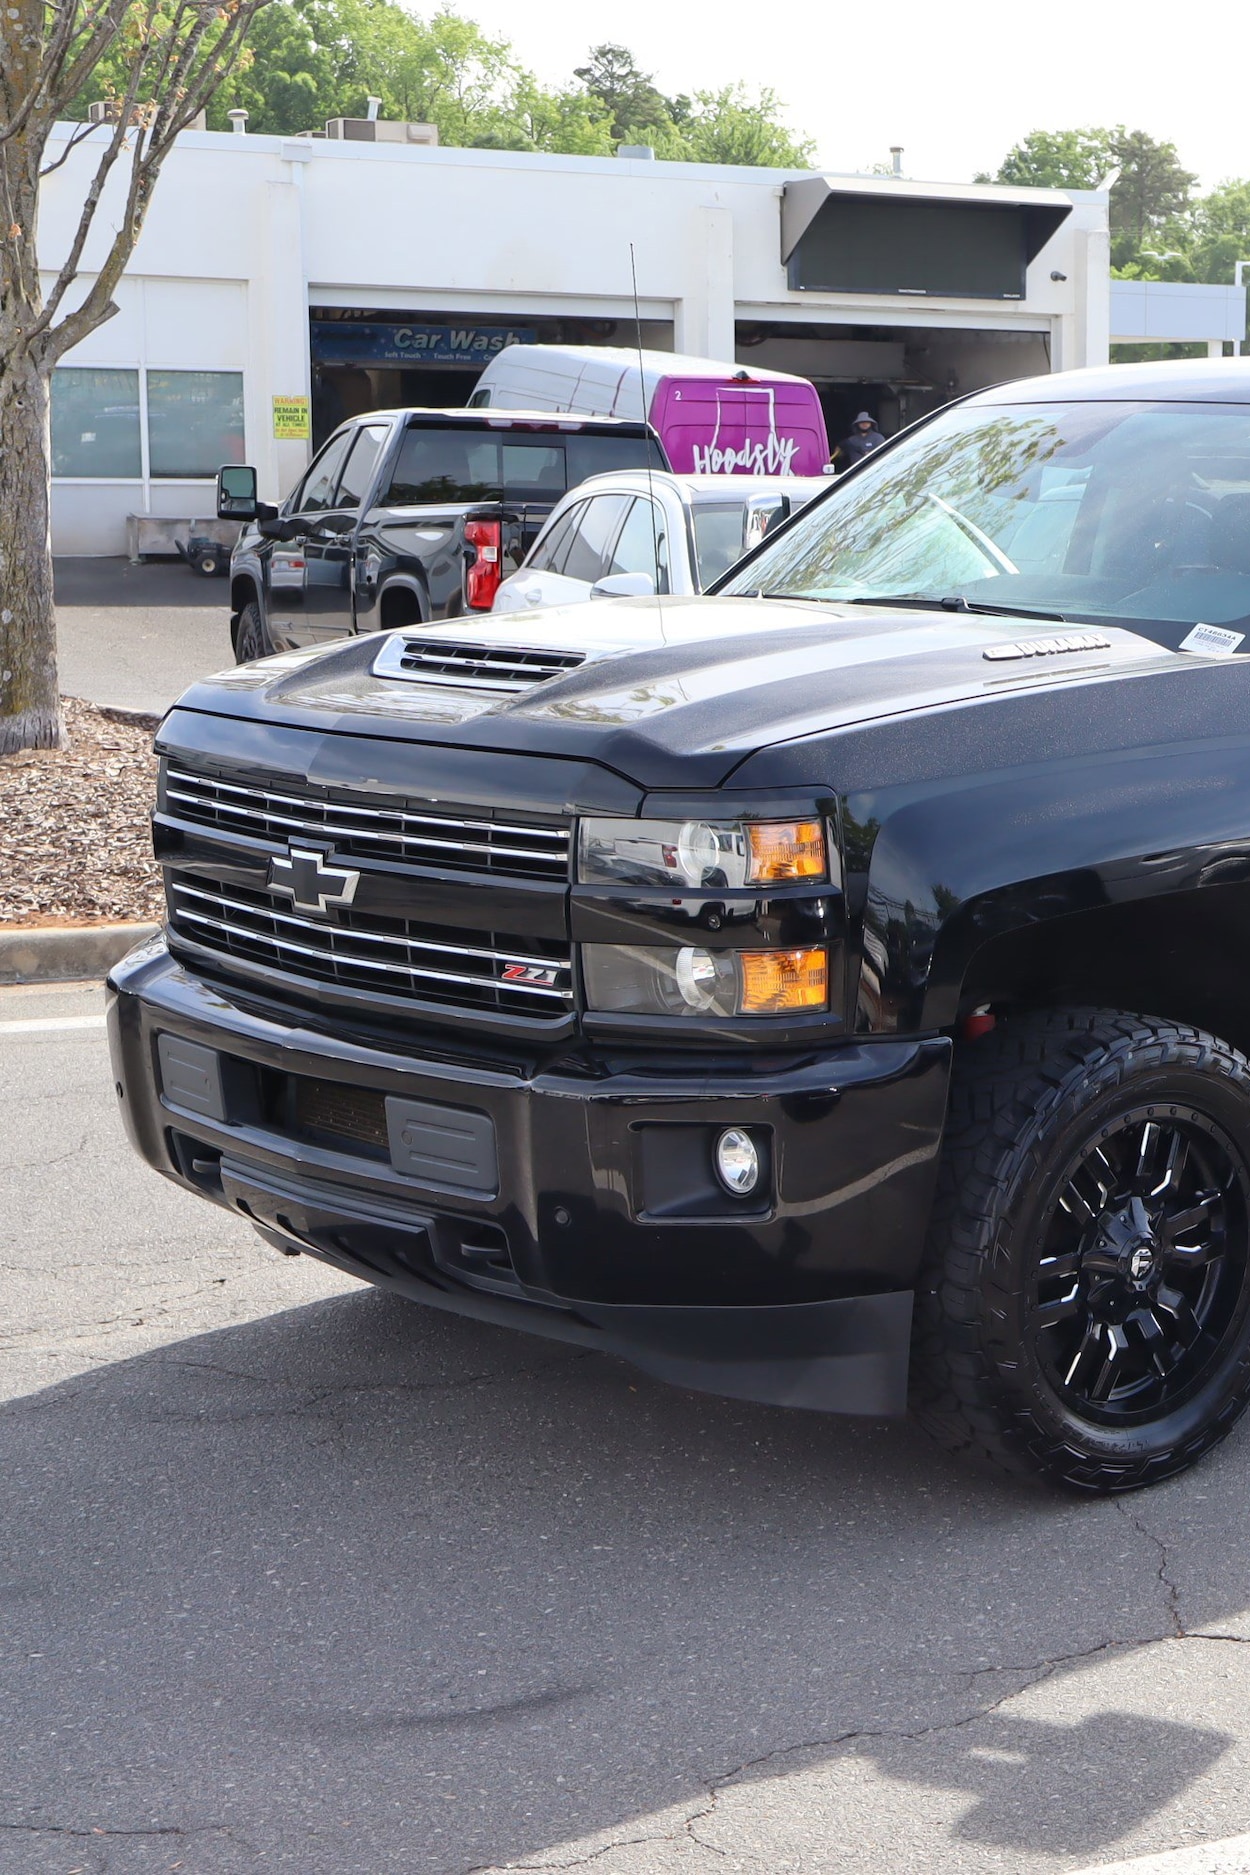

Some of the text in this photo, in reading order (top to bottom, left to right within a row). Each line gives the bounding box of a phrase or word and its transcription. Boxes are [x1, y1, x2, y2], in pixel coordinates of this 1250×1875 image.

[394, 328, 520, 351] Car Wash
[674, 390, 682, 400] 2
[692, 431, 800, 476] Hoodsly
[501, 963, 558, 987] Z71
